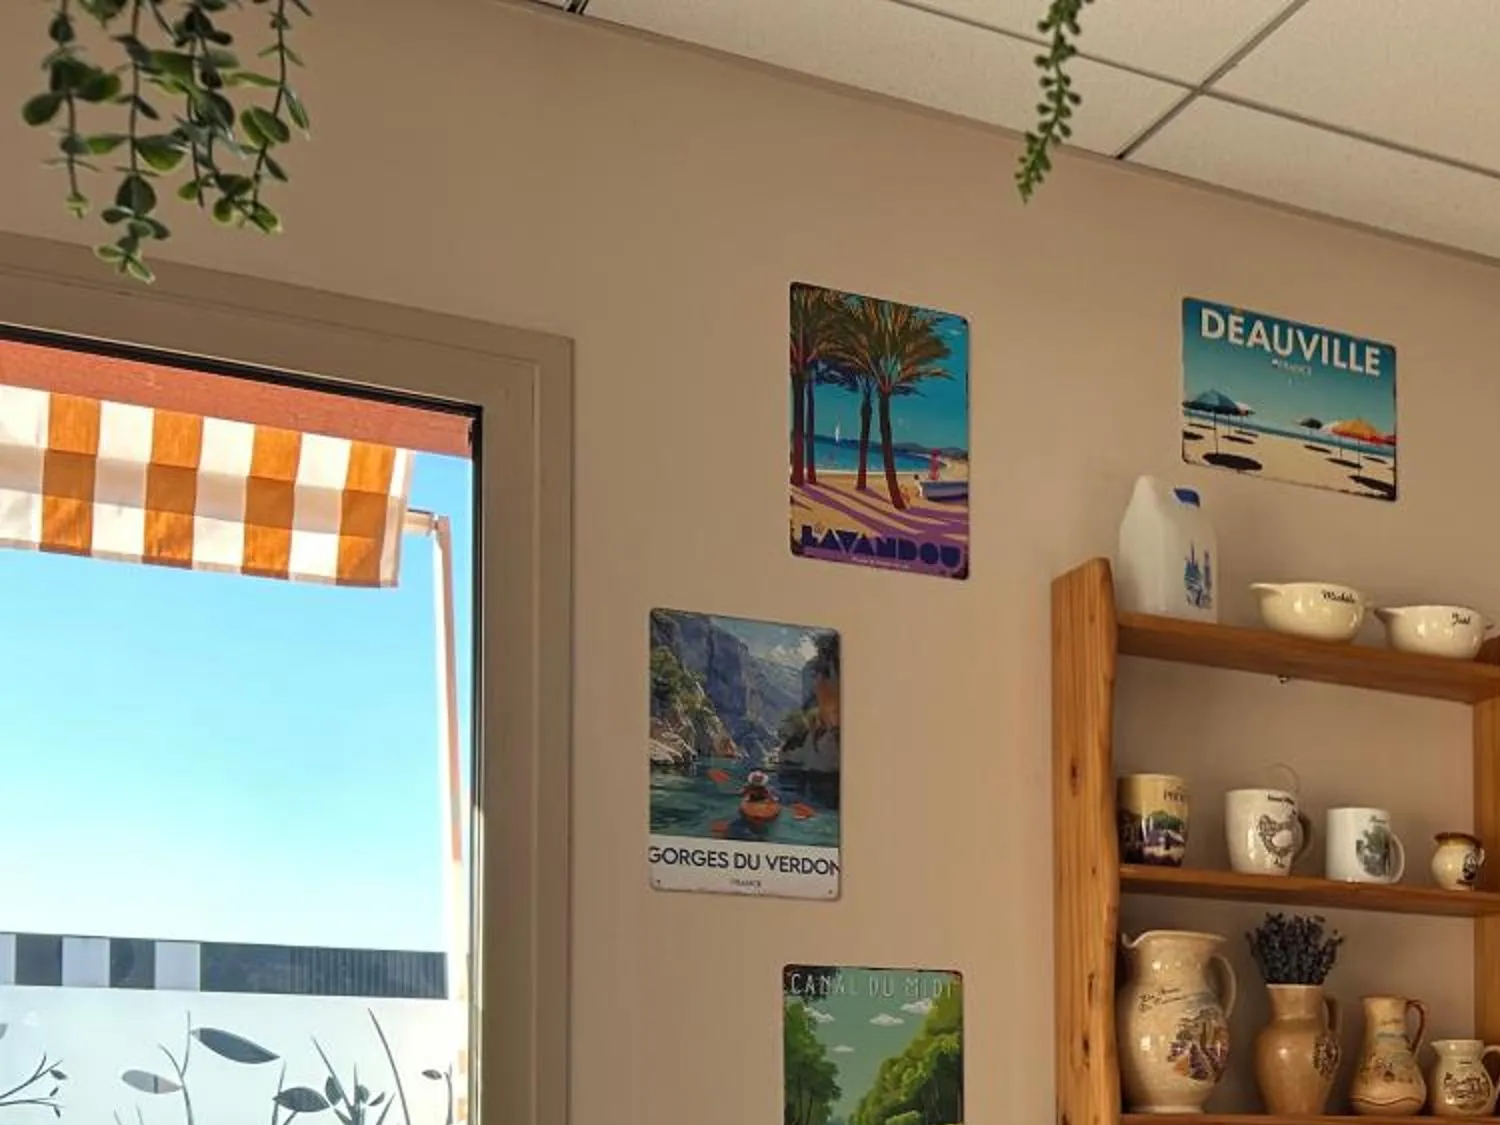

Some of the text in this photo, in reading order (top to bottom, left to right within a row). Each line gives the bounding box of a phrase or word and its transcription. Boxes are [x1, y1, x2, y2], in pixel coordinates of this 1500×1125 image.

[1201, 307, 1381, 377] DEAUVILLE
[801, 525, 961, 568] LAVANDOU
[648, 846, 840, 877] GORGES DU VERDON
[791, 972, 954, 999] CANAL DU MIDI
